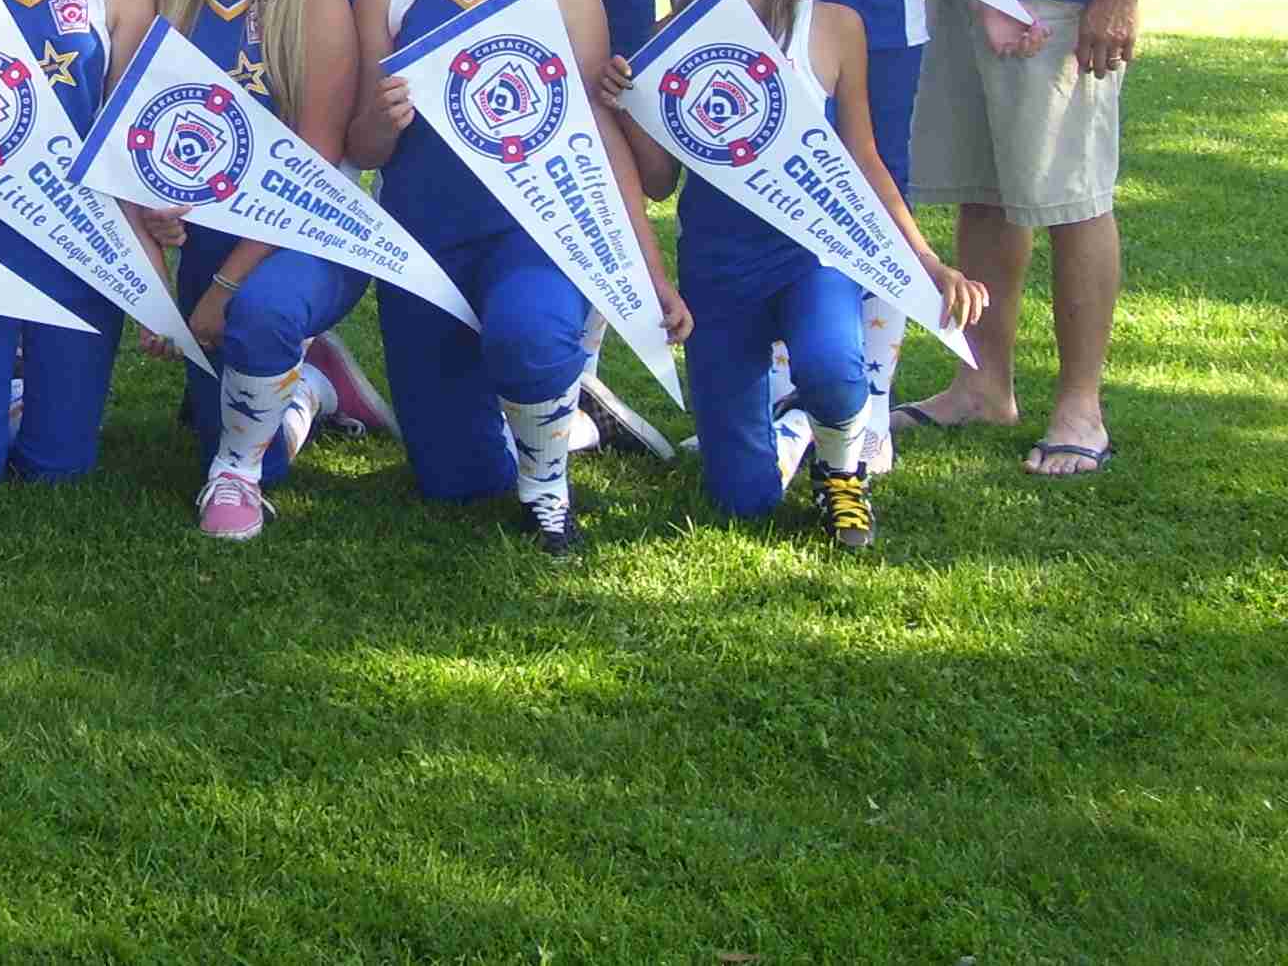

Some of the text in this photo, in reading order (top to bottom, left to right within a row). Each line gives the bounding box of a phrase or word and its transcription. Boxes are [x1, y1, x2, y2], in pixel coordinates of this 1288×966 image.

[475, 40, 543, 60] CHARACTER
[679, 47, 749, 74] CHARACTER
[3, 88, 31, 153] COURAGE
[141, 88, 203, 126] CHARACTER
[451, 92, 487, 147] LOYALTY
[528, 85, 563, 147] COURAGE
[667, 111, 714, 157] LOYALTY
[755, 82, 781, 146] COURAGE
[227, 109, 248, 175] COURAGE
[267, 137, 347, 204] California
[800, 126, 866, 212] California
[141, 165, 196, 200] LOYALTY
[568, 132, 616, 227] California
[26, 159, 149, 294] CHAMPIONS 2009
[226, 190, 406, 274] Little League SOFTBALL
[258, 168, 410, 262] CHAMPIONS 2009
[504, 161, 634, 321] Little League SOFTBALL
[543, 153, 643, 310] CHAMPIONS 2009
[741, 165, 905, 299] Little League SOFTBALL
[781, 152, 912, 286] CHAMPIONS 2009
[47, 223, 93, 266] League
[89, 263, 141, 307] SOFTBALL
